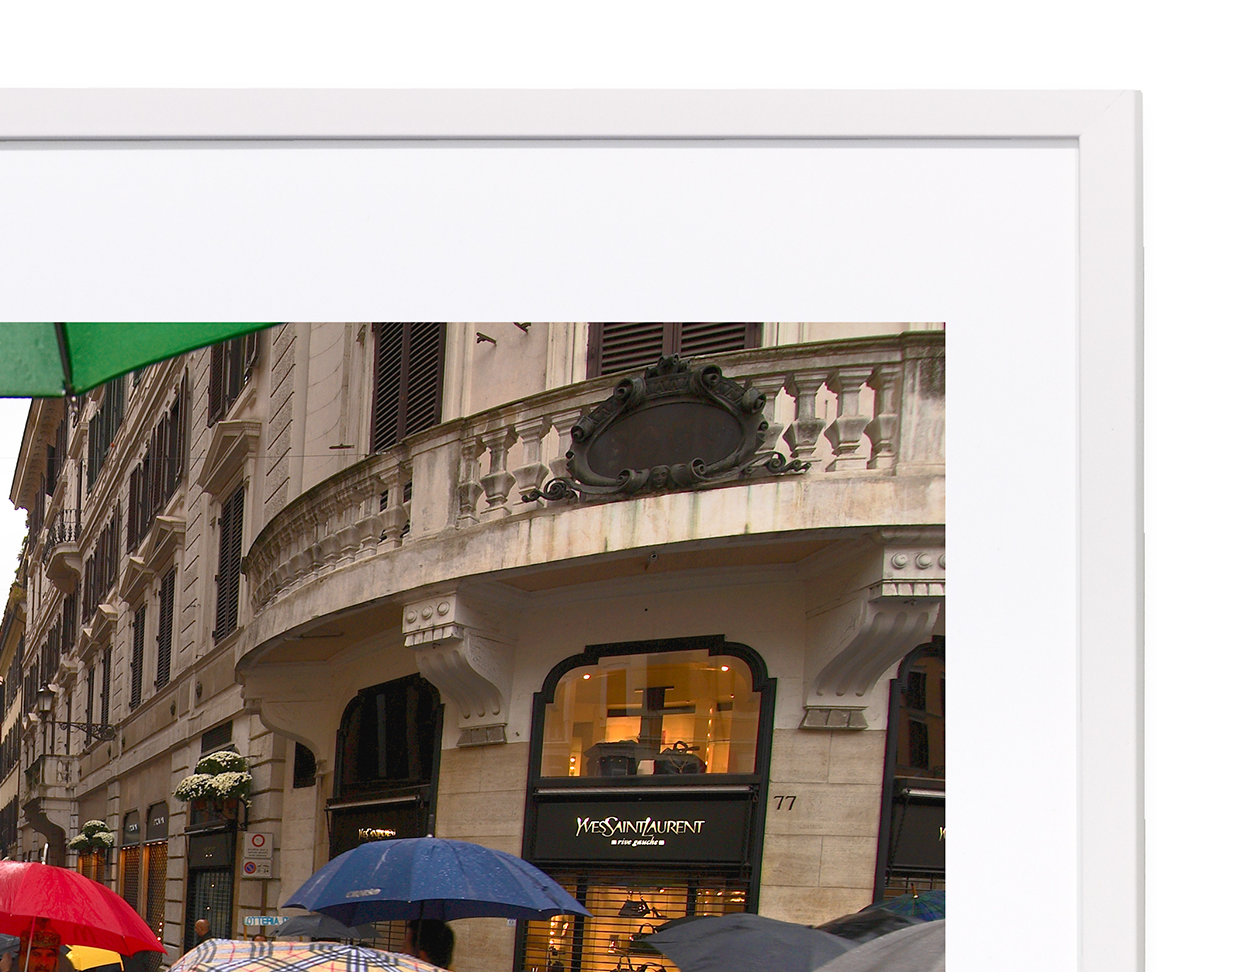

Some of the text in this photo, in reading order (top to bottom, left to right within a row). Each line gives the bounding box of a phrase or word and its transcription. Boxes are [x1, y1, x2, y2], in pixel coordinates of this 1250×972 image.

[773, 795, 797, 811] 77
[617, 835, 658, 847] rive gauche
